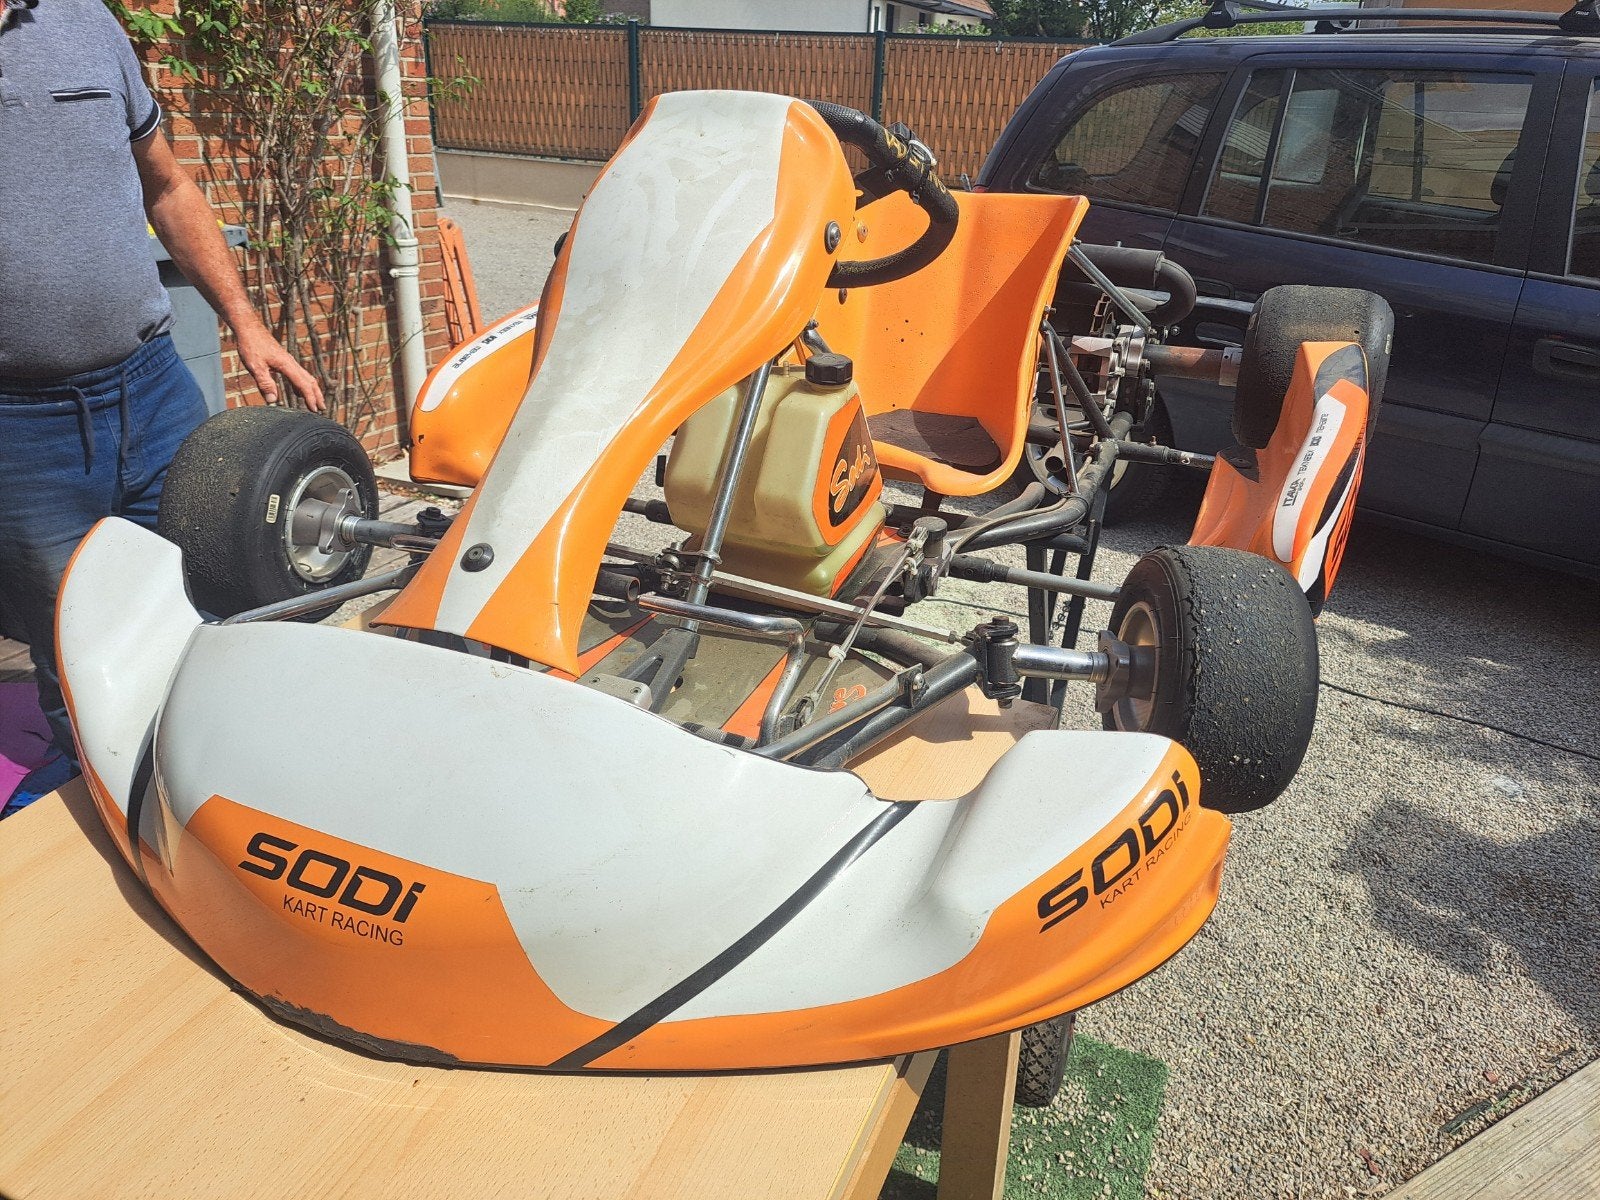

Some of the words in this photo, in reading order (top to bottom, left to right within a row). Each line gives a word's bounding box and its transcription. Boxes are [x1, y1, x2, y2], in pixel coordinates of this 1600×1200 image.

[1100, 868, 1141, 909] KART
[1146, 811, 1192, 871] RACING
[283, 894, 328, 923] KART
[331, 911, 403, 946] RACING
